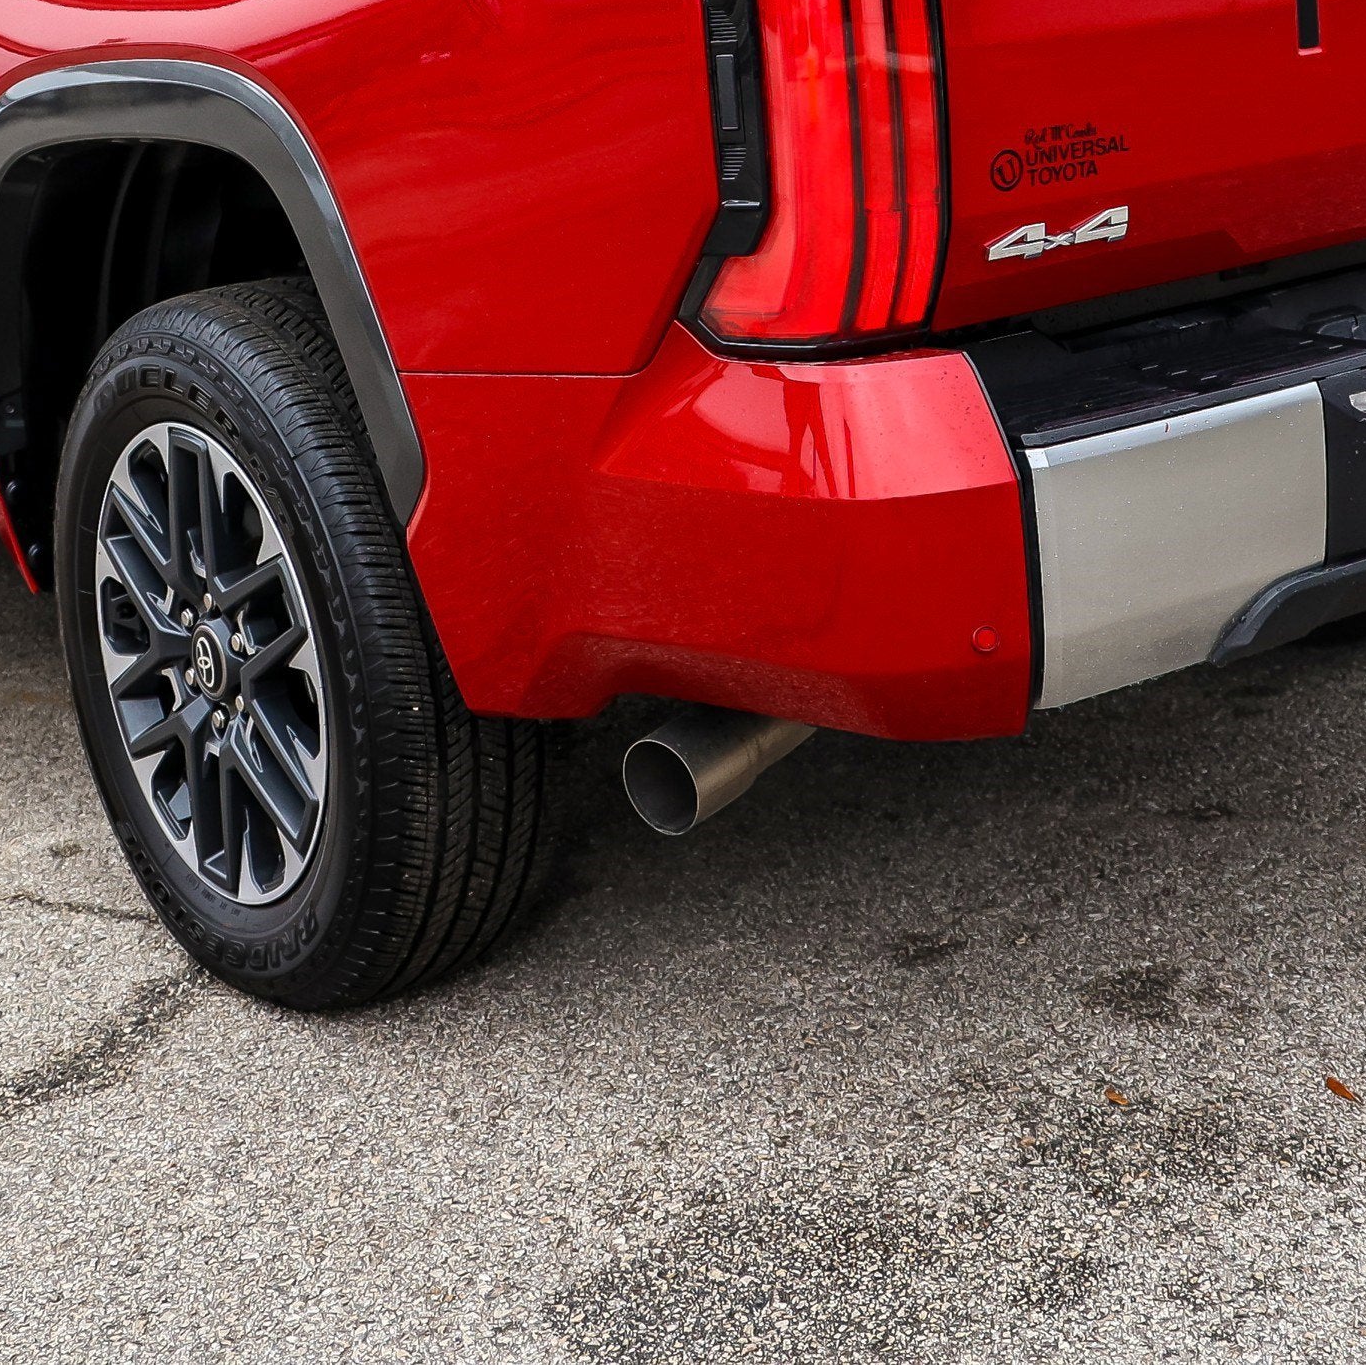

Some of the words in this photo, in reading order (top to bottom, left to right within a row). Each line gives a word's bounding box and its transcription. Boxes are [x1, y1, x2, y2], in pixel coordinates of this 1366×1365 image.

[1024, 135, 1131, 167] UNIVERSAL
[1026, 160, 1099, 187] TOYOTA
[92, 363, 243, 446] DUELER
